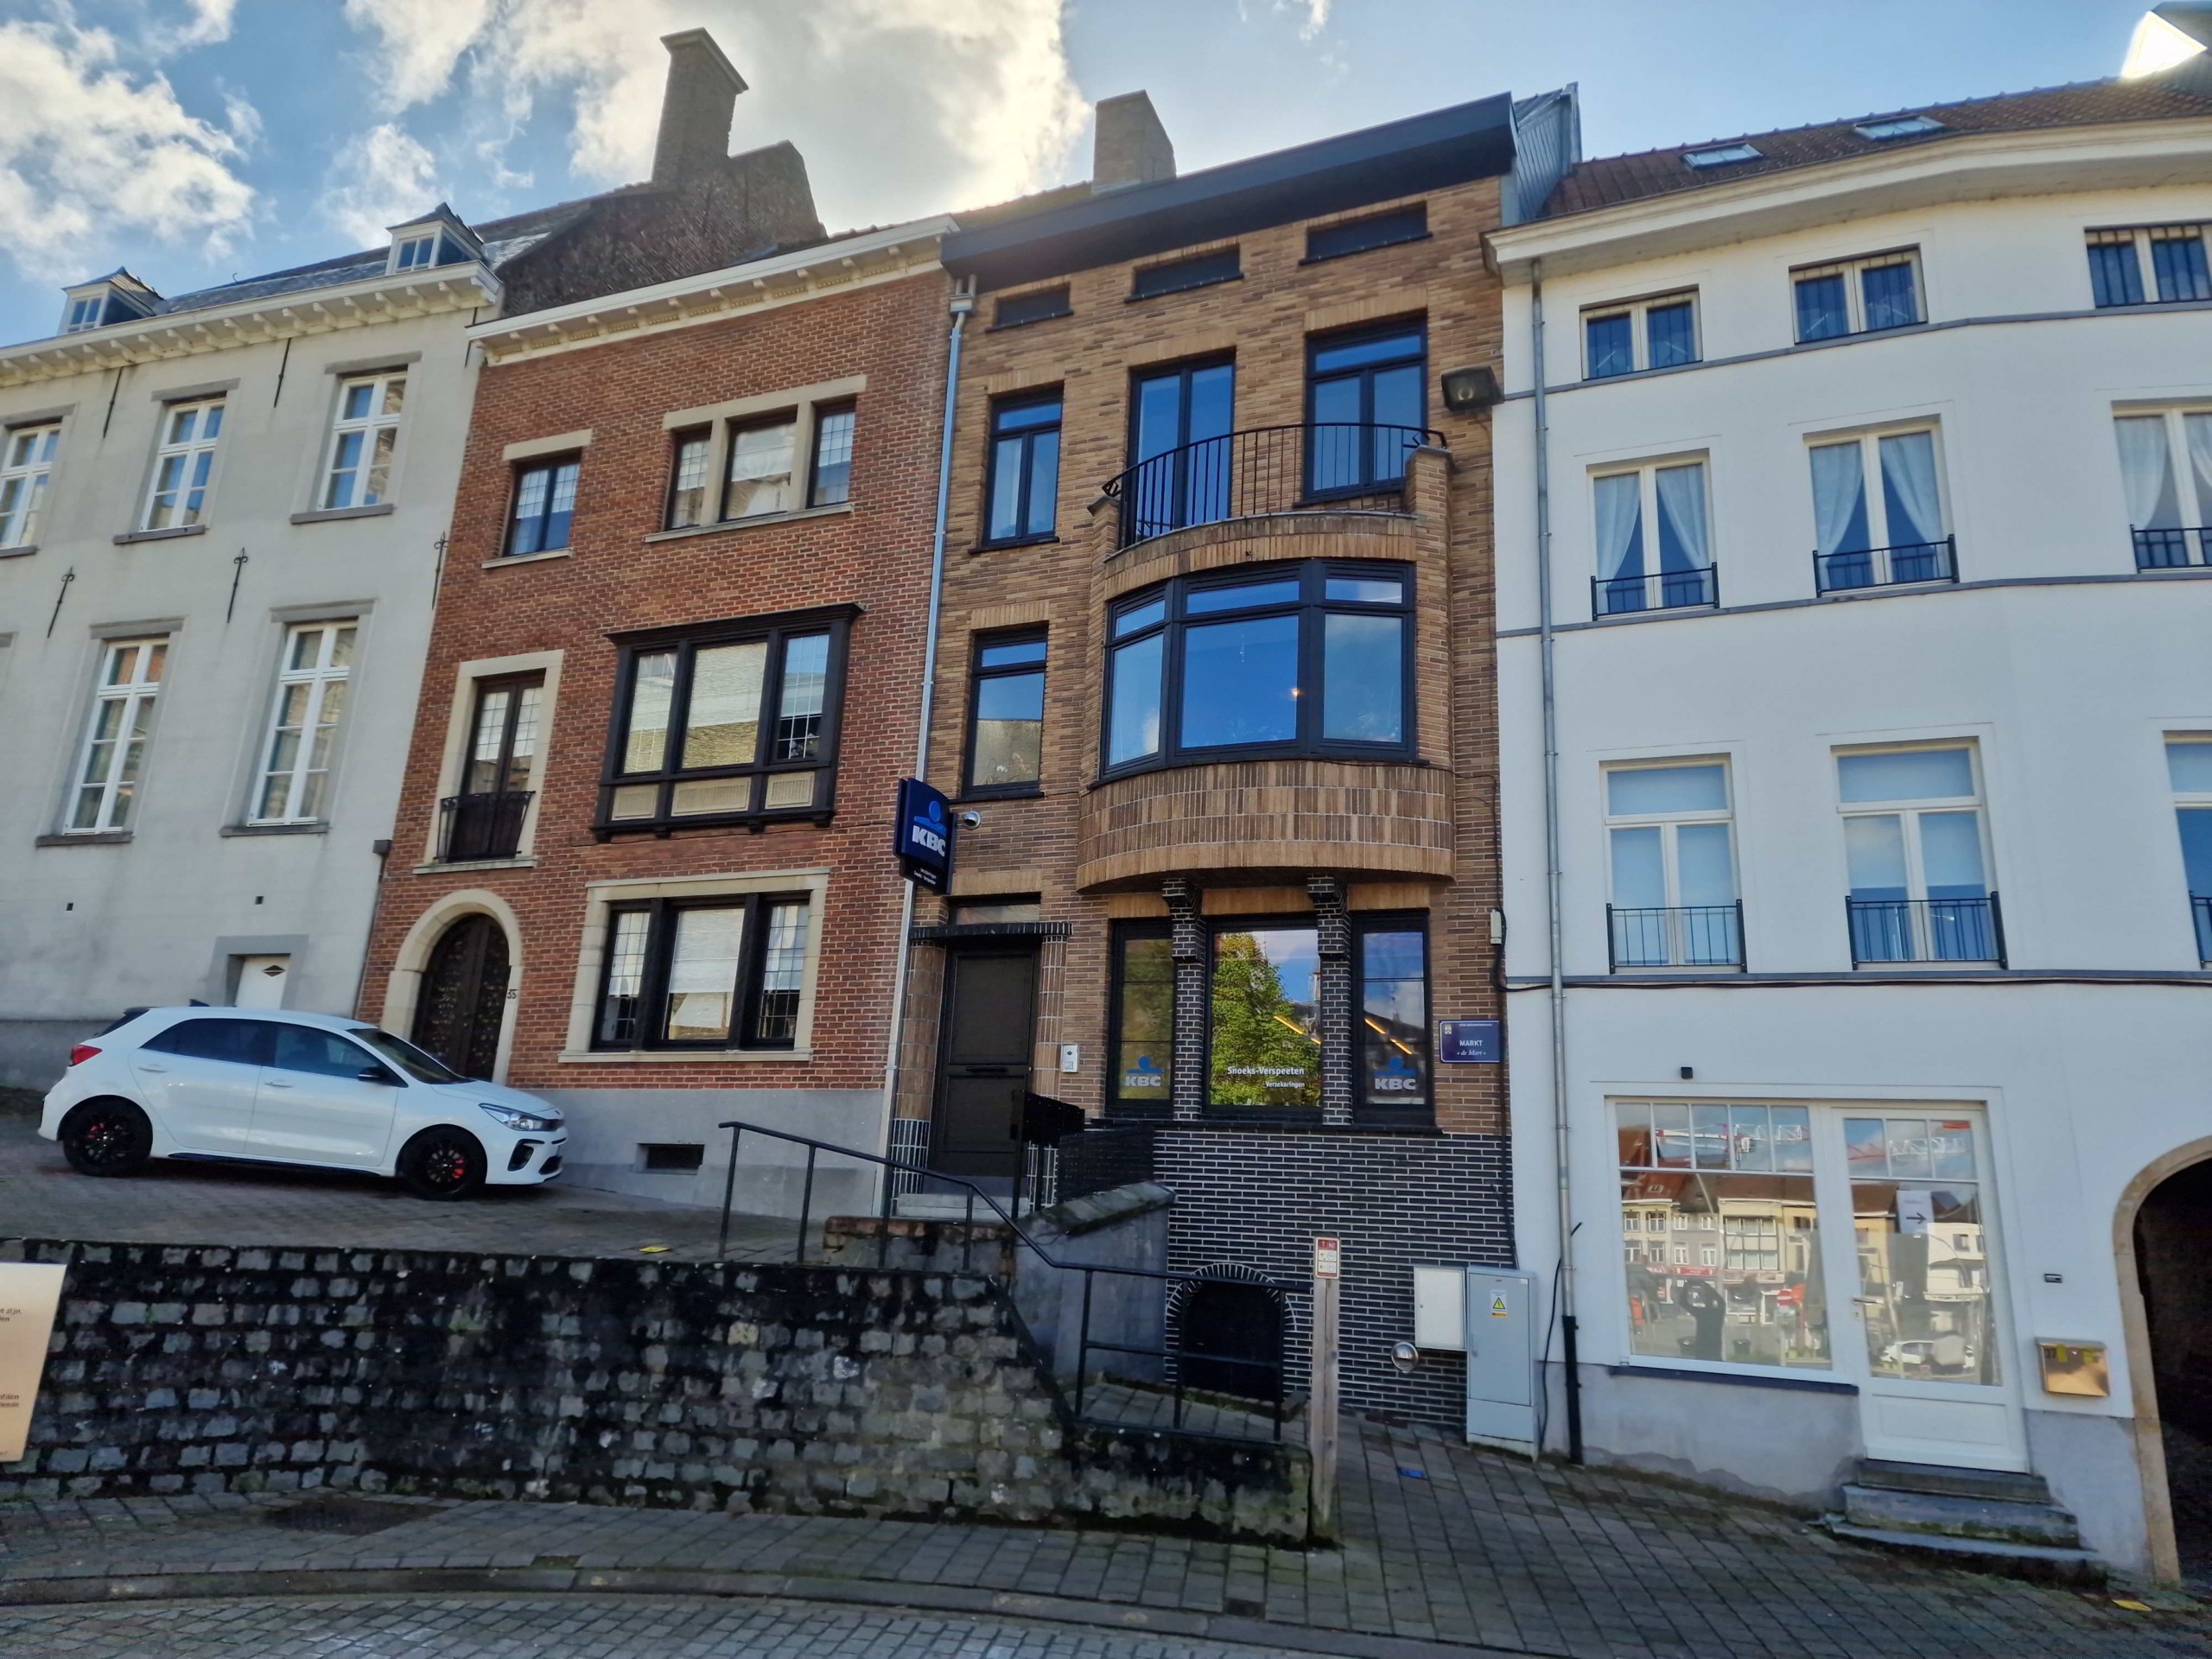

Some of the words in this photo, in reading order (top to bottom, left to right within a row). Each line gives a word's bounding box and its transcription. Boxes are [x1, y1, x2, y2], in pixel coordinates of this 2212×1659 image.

[912, 824, 946, 858] KBC
[507, 988, 518, 1000] 35
[1227, 1065, 1305, 1077] Snoeks-Verspeeten
[1125, 1076, 1161, 1087] KBC
[1265, 1080, 1306, 1089] Verzekeringen
[1375, 1078, 1416, 1090] KBC
